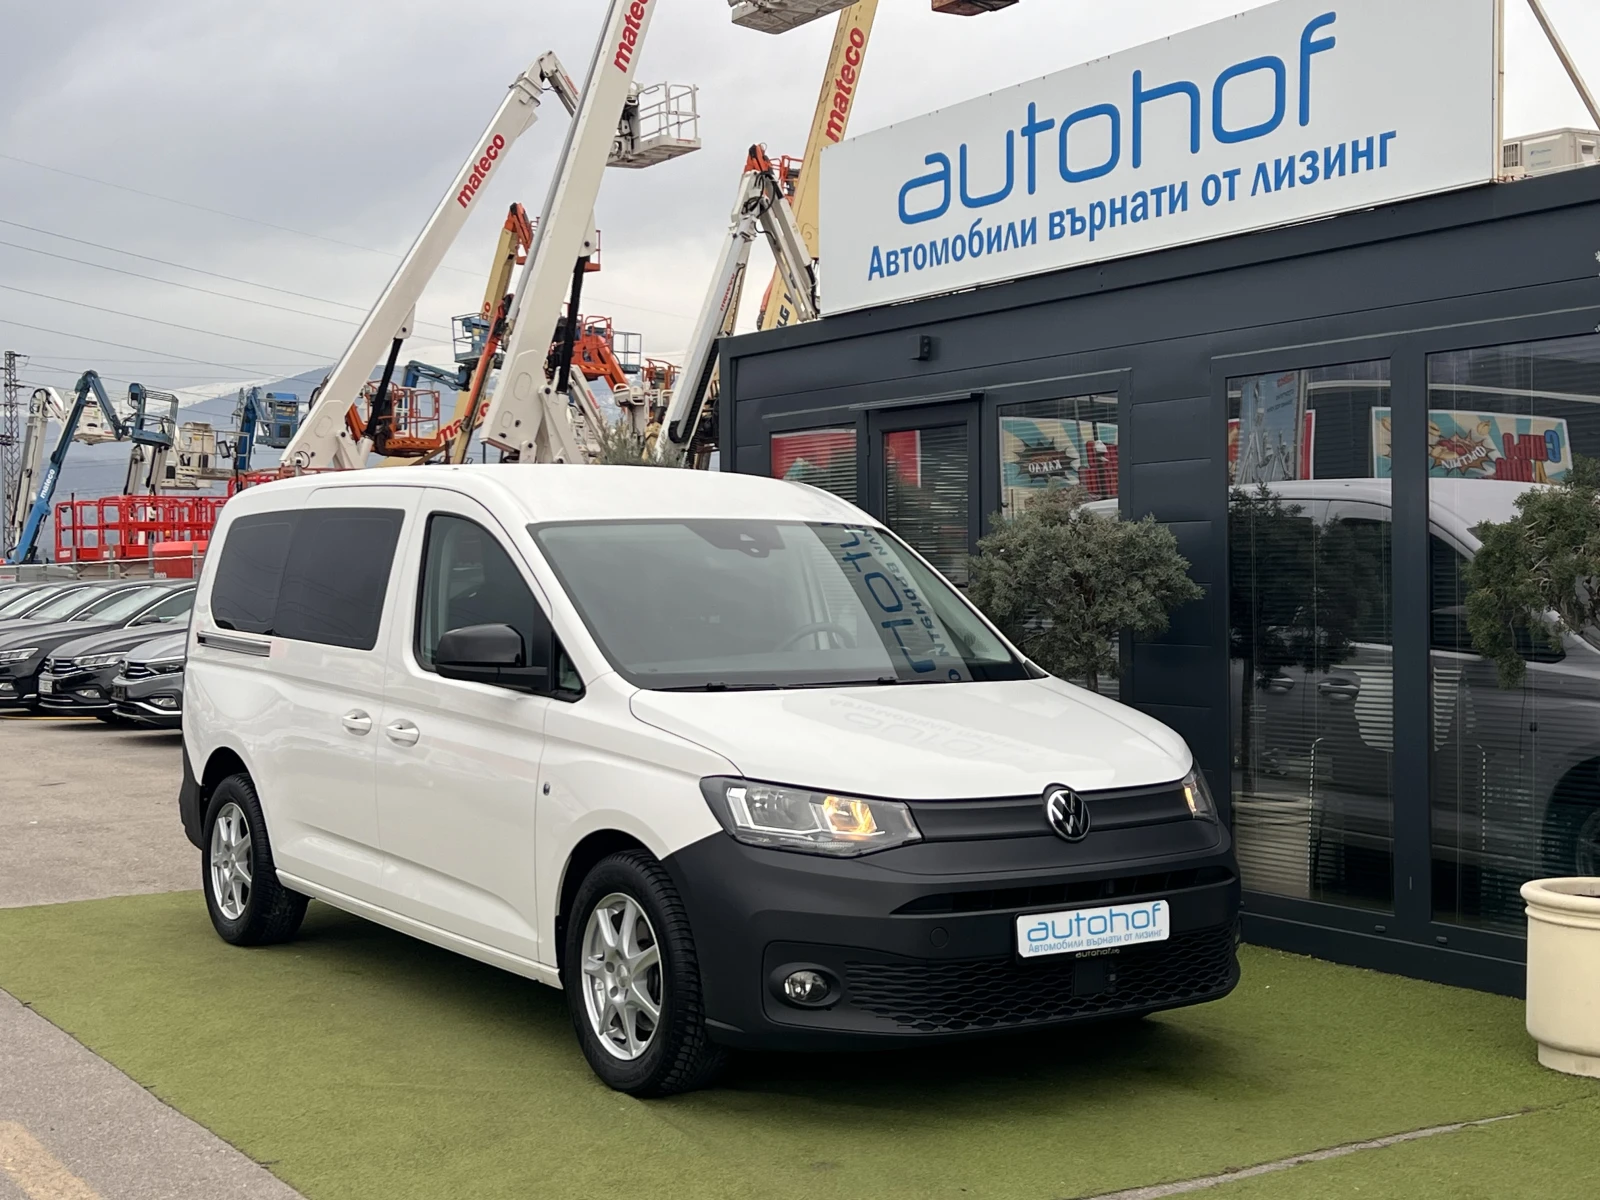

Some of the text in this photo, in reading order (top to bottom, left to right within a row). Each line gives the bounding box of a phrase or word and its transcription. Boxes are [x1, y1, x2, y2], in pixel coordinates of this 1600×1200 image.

[613, 0, 649, 74] mate
[825, 27, 865, 143] mateco
[898, 12, 1337, 226] autohof
[457, 134, 505, 209] mateco
[868, 130, 1396, 279] Автомобили върнати от лизинг
[1027, 902, 1162, 942] autohof
[1028, 929, 1163, 953] Автомобили върнати от лизинг
